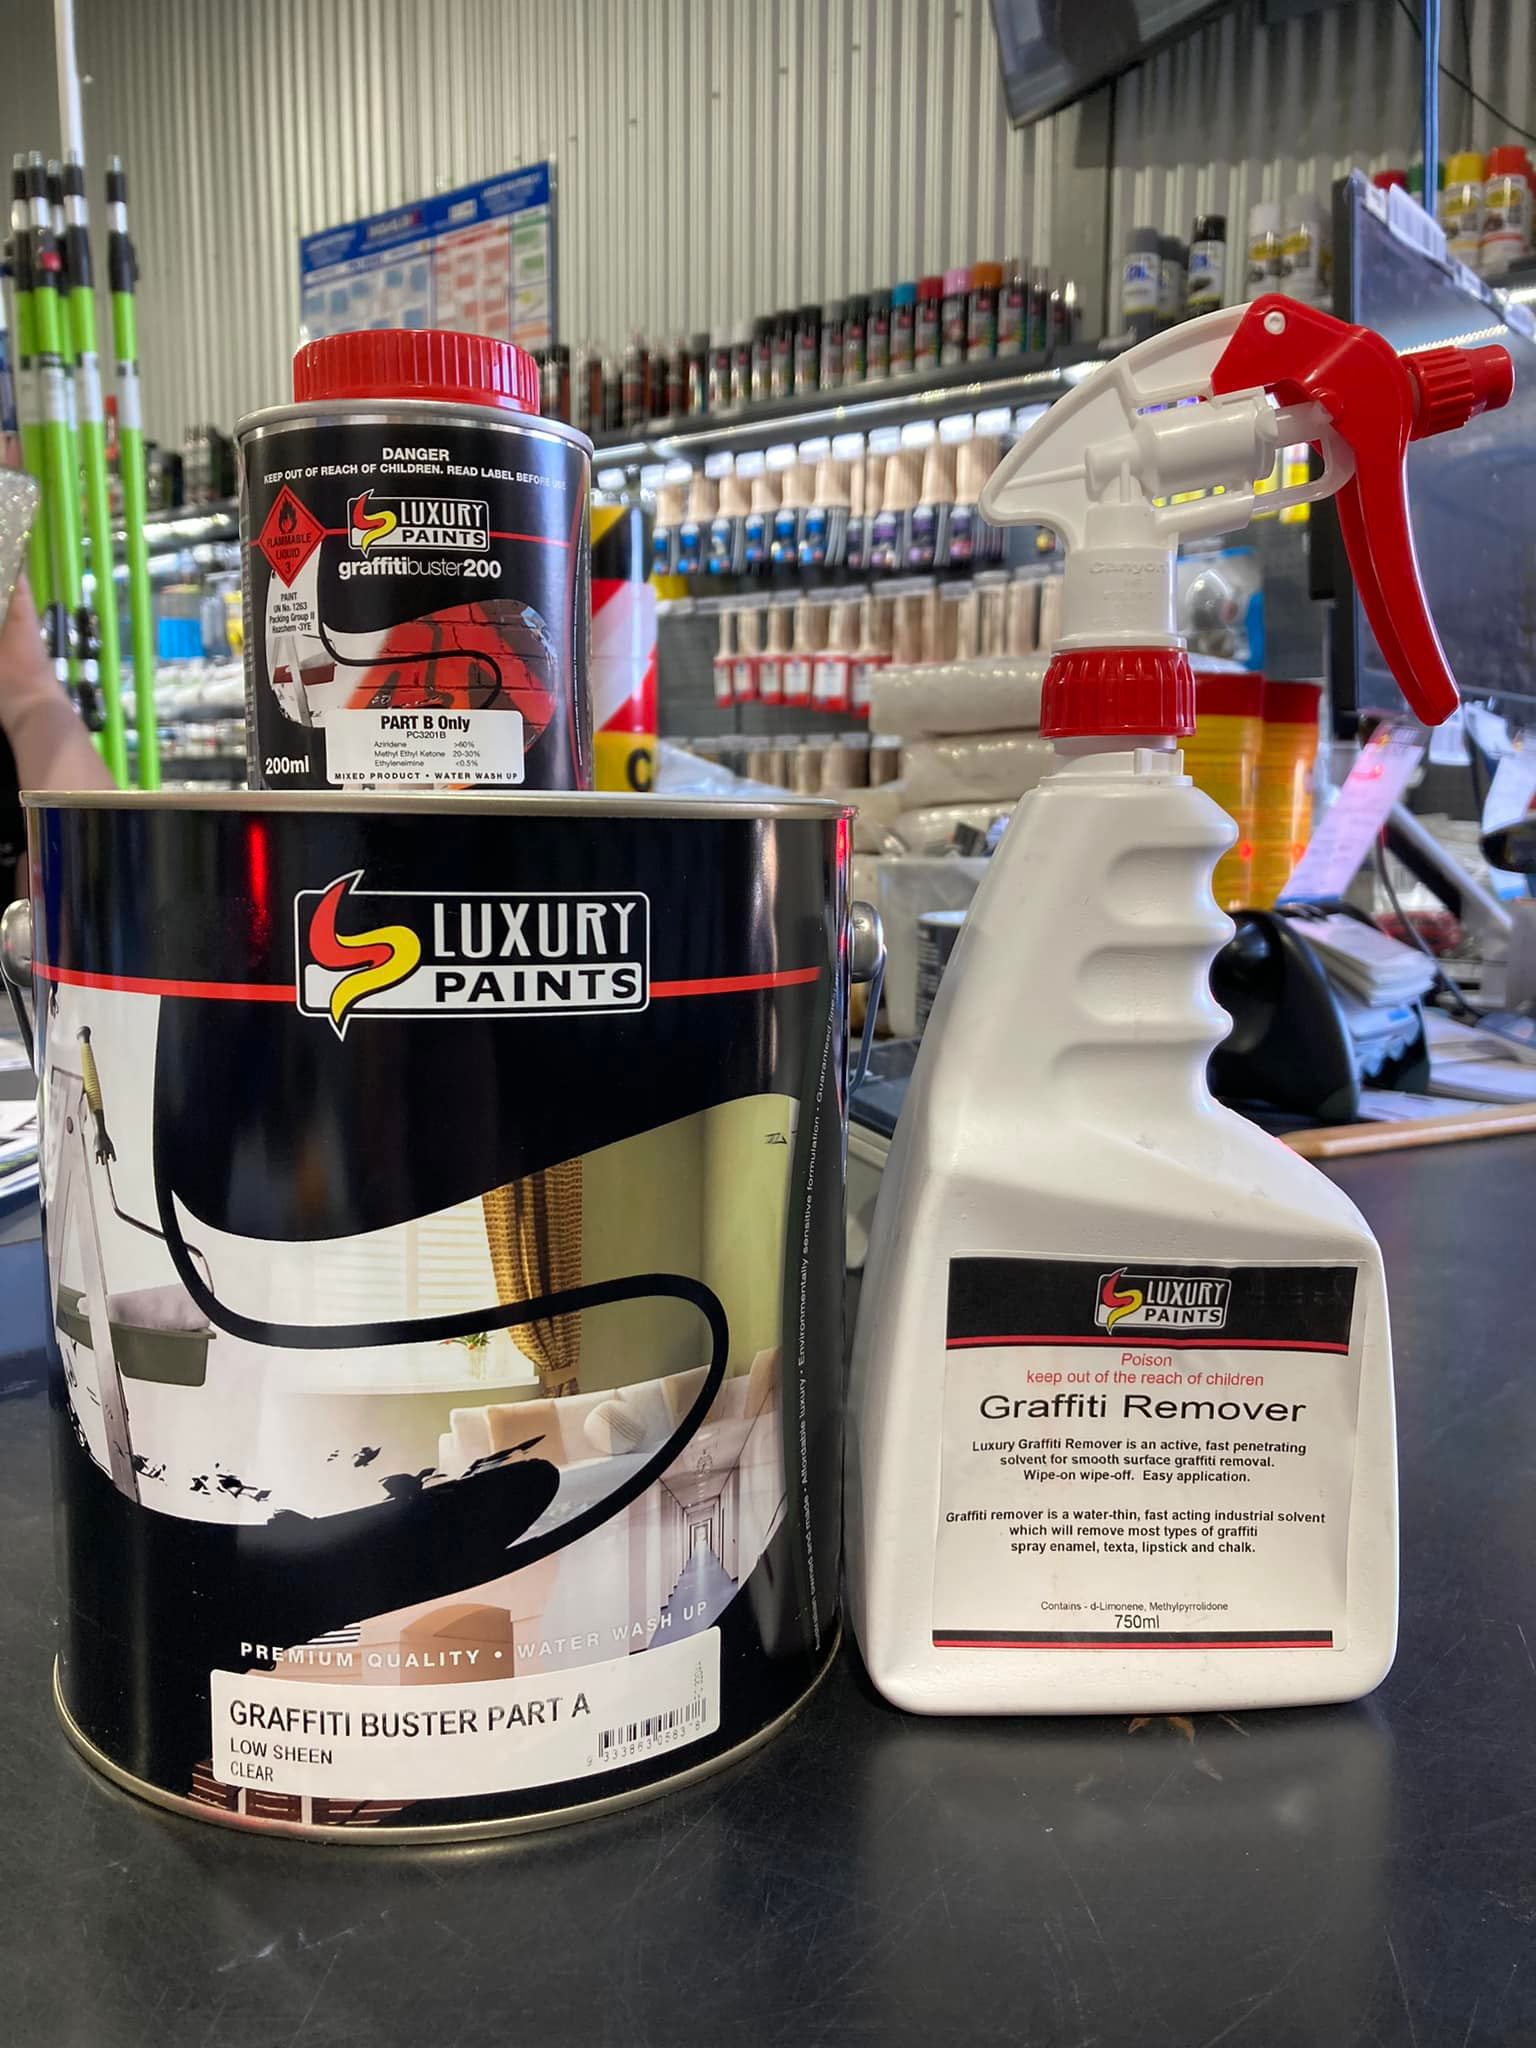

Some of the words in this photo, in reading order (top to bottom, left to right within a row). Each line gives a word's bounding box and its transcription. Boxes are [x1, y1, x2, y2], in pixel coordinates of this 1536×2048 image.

[382, 447, 450, 462] DANGER
[263, 472, 283, 485] KEEP
[284, 469, 304, 480] OUT
[305, 466, 319, 477] OF
[321, 464, 358, 476] REACH
[360, 463, 377, 474] OF
[379, 463, 444, 474] CHILDREN.
[447, 465, 478, 476] READ
[481, 467, 514, 481] LABEL
[401, 501, 483, 527] LUXURY
[266, 533, 311, 548] FLAMMABLE
[402, 529, 485, 546] PAINTS
[275, 548, 300, 560] LIQUID
[285, 562, 292, 574] 3
[338, 556, 502, 580] graffitibuster200
[280, 592, 298, 601] PAINT
[290, 612, 309, 622] Group
[381, 715, 419, 730] PART
[423, 715, 434, 730] B
[438, 715, 471, 732] Only
[406, 731, 447, 739] PC3201B
[374, 750, 398, 758] Methyl
[400, 750, 418, 758] Ethyl
[420, 750, 446, 758] Ketone
[265, 755, 310, 775] 200ml
[334, 772, 366, 780] MIXED
[370, 772, 421, 780] PRODUCT
[434, 772, 471, 780] WATER
[433, 902, 637, 959] LUXURY
[434, 967, 637, 1003] PAINTS
[816, 1025, 833, 1103] Guaranteed
[806, 1115, 821, 1191] formulation
[801, 1194, 812, 1255] sensitive
[1145, 1279, 1226, 1308] LUXURY
[797, 1258, 810, 1367] Environmentally
[1144, 1307, 1222, 1324] PAINTS
[1120, 1352, 1172, 1368] Poison
[1026, 1370, 1062, 1386] keep
[1067, 1370, 1090, 1385] out
[1094, 1369, 1108, 1384] of
[1113, 1370, 1136, 1384] the
[1140, 1371, 1182, 1385] reach
[1187, 1371, 1203, 1386] of
[1206, 1372, 1264, 1387] children
[798, 1378, 808, 1419] luxury
[979, 1393, 1107, 1421] Graffiti
[1123, 1393, 1307, 1423] Remover
[972, 1440, 1015, 1452] Luxury
[1018, 1438, 1062, 1449] Graffiti
[1065, 1438, 1122, 1449] Remover
[1126, 1438, 1137, 1449] is
[1141, 1441, 1156, 1449] an
[1160, 1440, 1201, 1452] active,
[1206, 1440, 1229, 1450] fast
[1233, 1441, 1307, 1456] penetrating
[1000, 1454, 1047, 1465] solvent
[1050, 1454, 1068, 1464] for
[1071, 1454, 1119, 1465] smooth
[1123, 1454, 1171, 1465] surface
[1174, 1455, 1216, 1468] graffiti
[1219, 1456, 1275, 1467] removal.
[1024, 1470, 1076, 1482] Wipe-on
[1080, 1470, 1135, 1482] wipe-off.
[1143, 1470, 1173, 1483] Easy
[1177, 1470, 1250, 1484] application.
[946, 1510, 987, 1522] Graffiti
[990, 1509, 1043, 1520] remover
[1047, 1508, 1058, 1519] is
[1062, 1511, 1069, 1520] a
[1073, 1509, 1141, 1521] water-thin,
[1144, 1509, 1168, 1520] fast
[1171, 1509, 1211, 1523] acting
[1214, 1510, 1274, 1521] industrial
[1277, 1512, 1326, 1523] solvent
[1009, 1525, 1047, 1536] which
[1051, 1525, 1073, 1536] will
[1077, 1527, 1124, 1536] remove
[1128, 1526, 1160, 1536] most
[1164, 1526, 1197, 1539] types
[1201, 1525, 1214, 1536] of
[1217, 1525, 1258, 1539] graffiti
[1011, 1542, 1046, 1554] spray
[1050, 1541, 1100, 1553] enamel,
[1103, 1542, 1138, 1553] texta,
[1142, 1542, 1188, 1555] lipstick
[1191, 1542, 1214, 1553] and
[1218, 1542, 1255, 1553] chalk.
[1041, 1601, 1081, 1611] Contains
[1090, 1601, 1147, 1611] d-Limonene,
[1149, 1602, 1228, 1612] Methylpyrrolidone
[1114, 1614, 1160, 1629] 750ml
[240, 1641, 353, 1667] PREMIUM
[368, 1649, 480, 1668] QUALITY
[517, 1632, 600, 1660] WATER
[612, 1612, 673, 1641] WASH
[683, 1601, 708, 1621] UP
[230, 1699, 351, 1737] GRAFFITI
[361, 1709, 479, 1738] BUSTER
[488, 1697, 563, 1731] PART
[571, 1692, 592, 1718] A
[230, 1737, 267, 1758] LOW
[273, 1744, 333, 1765] SHEEN
[230, 1760, 274, 1782] CLEAR
